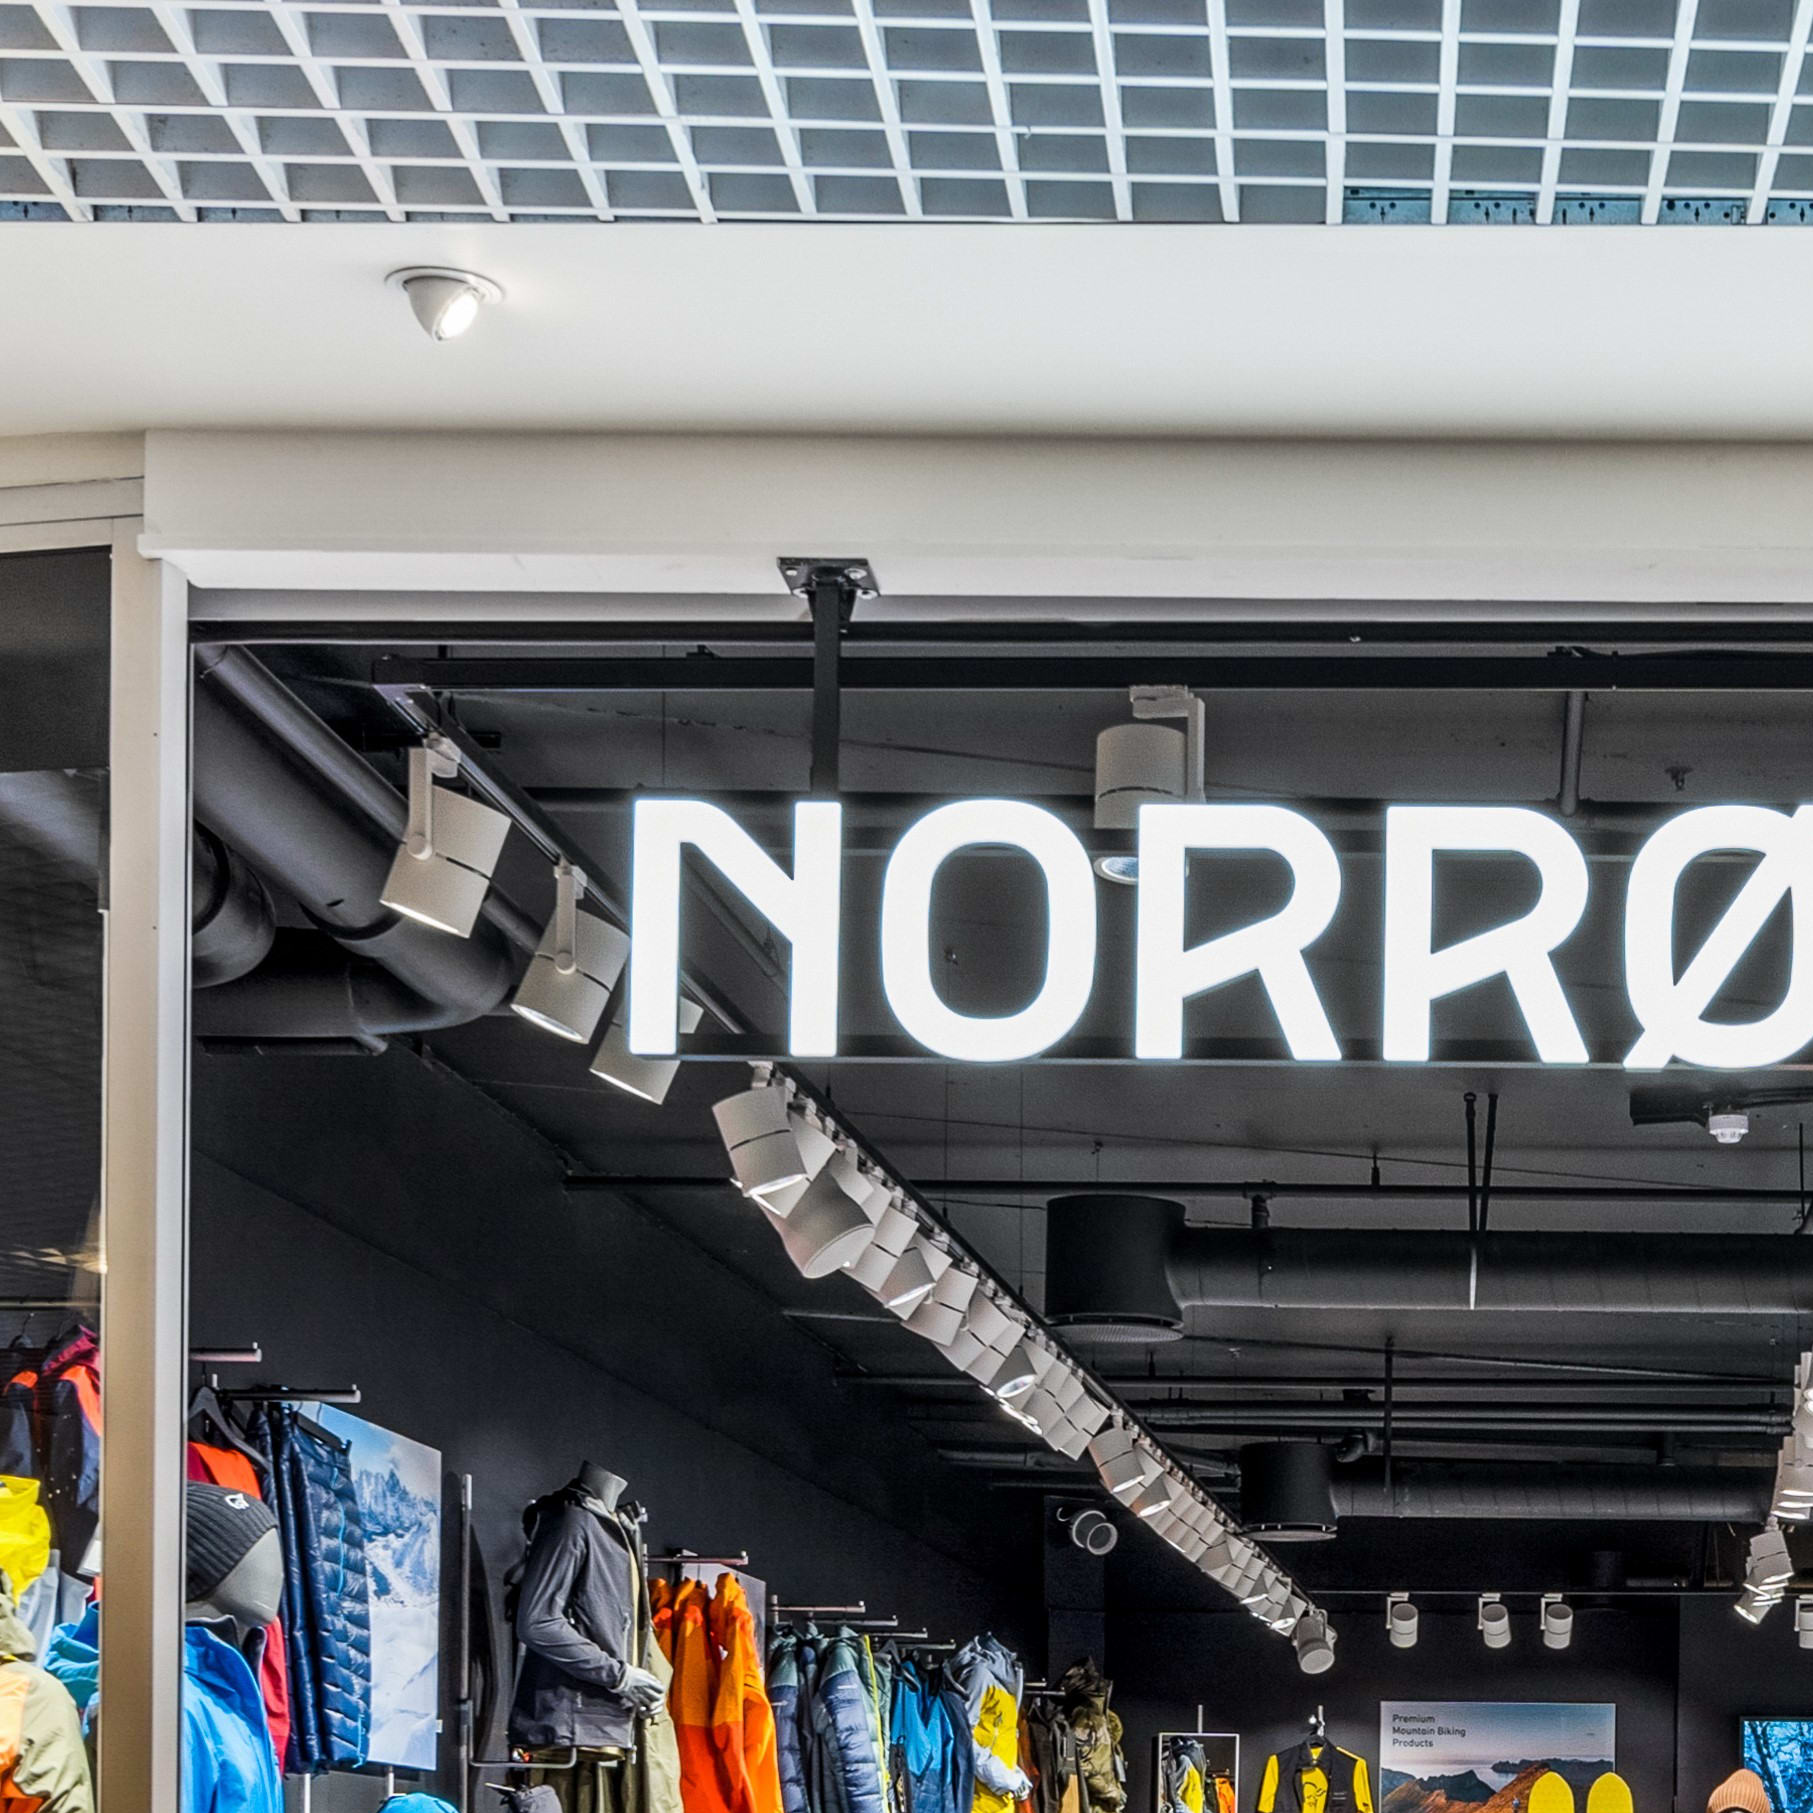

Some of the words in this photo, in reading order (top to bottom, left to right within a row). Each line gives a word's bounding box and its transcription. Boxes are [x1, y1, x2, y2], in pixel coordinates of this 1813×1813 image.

[1392, 1714, 1436, 1724] Premium
[1392, 1726, 1436, 1736] Mountain
[1437, 1726, 1467, 1738] Biking
[1392, 1738, 1435, 1748] Products
